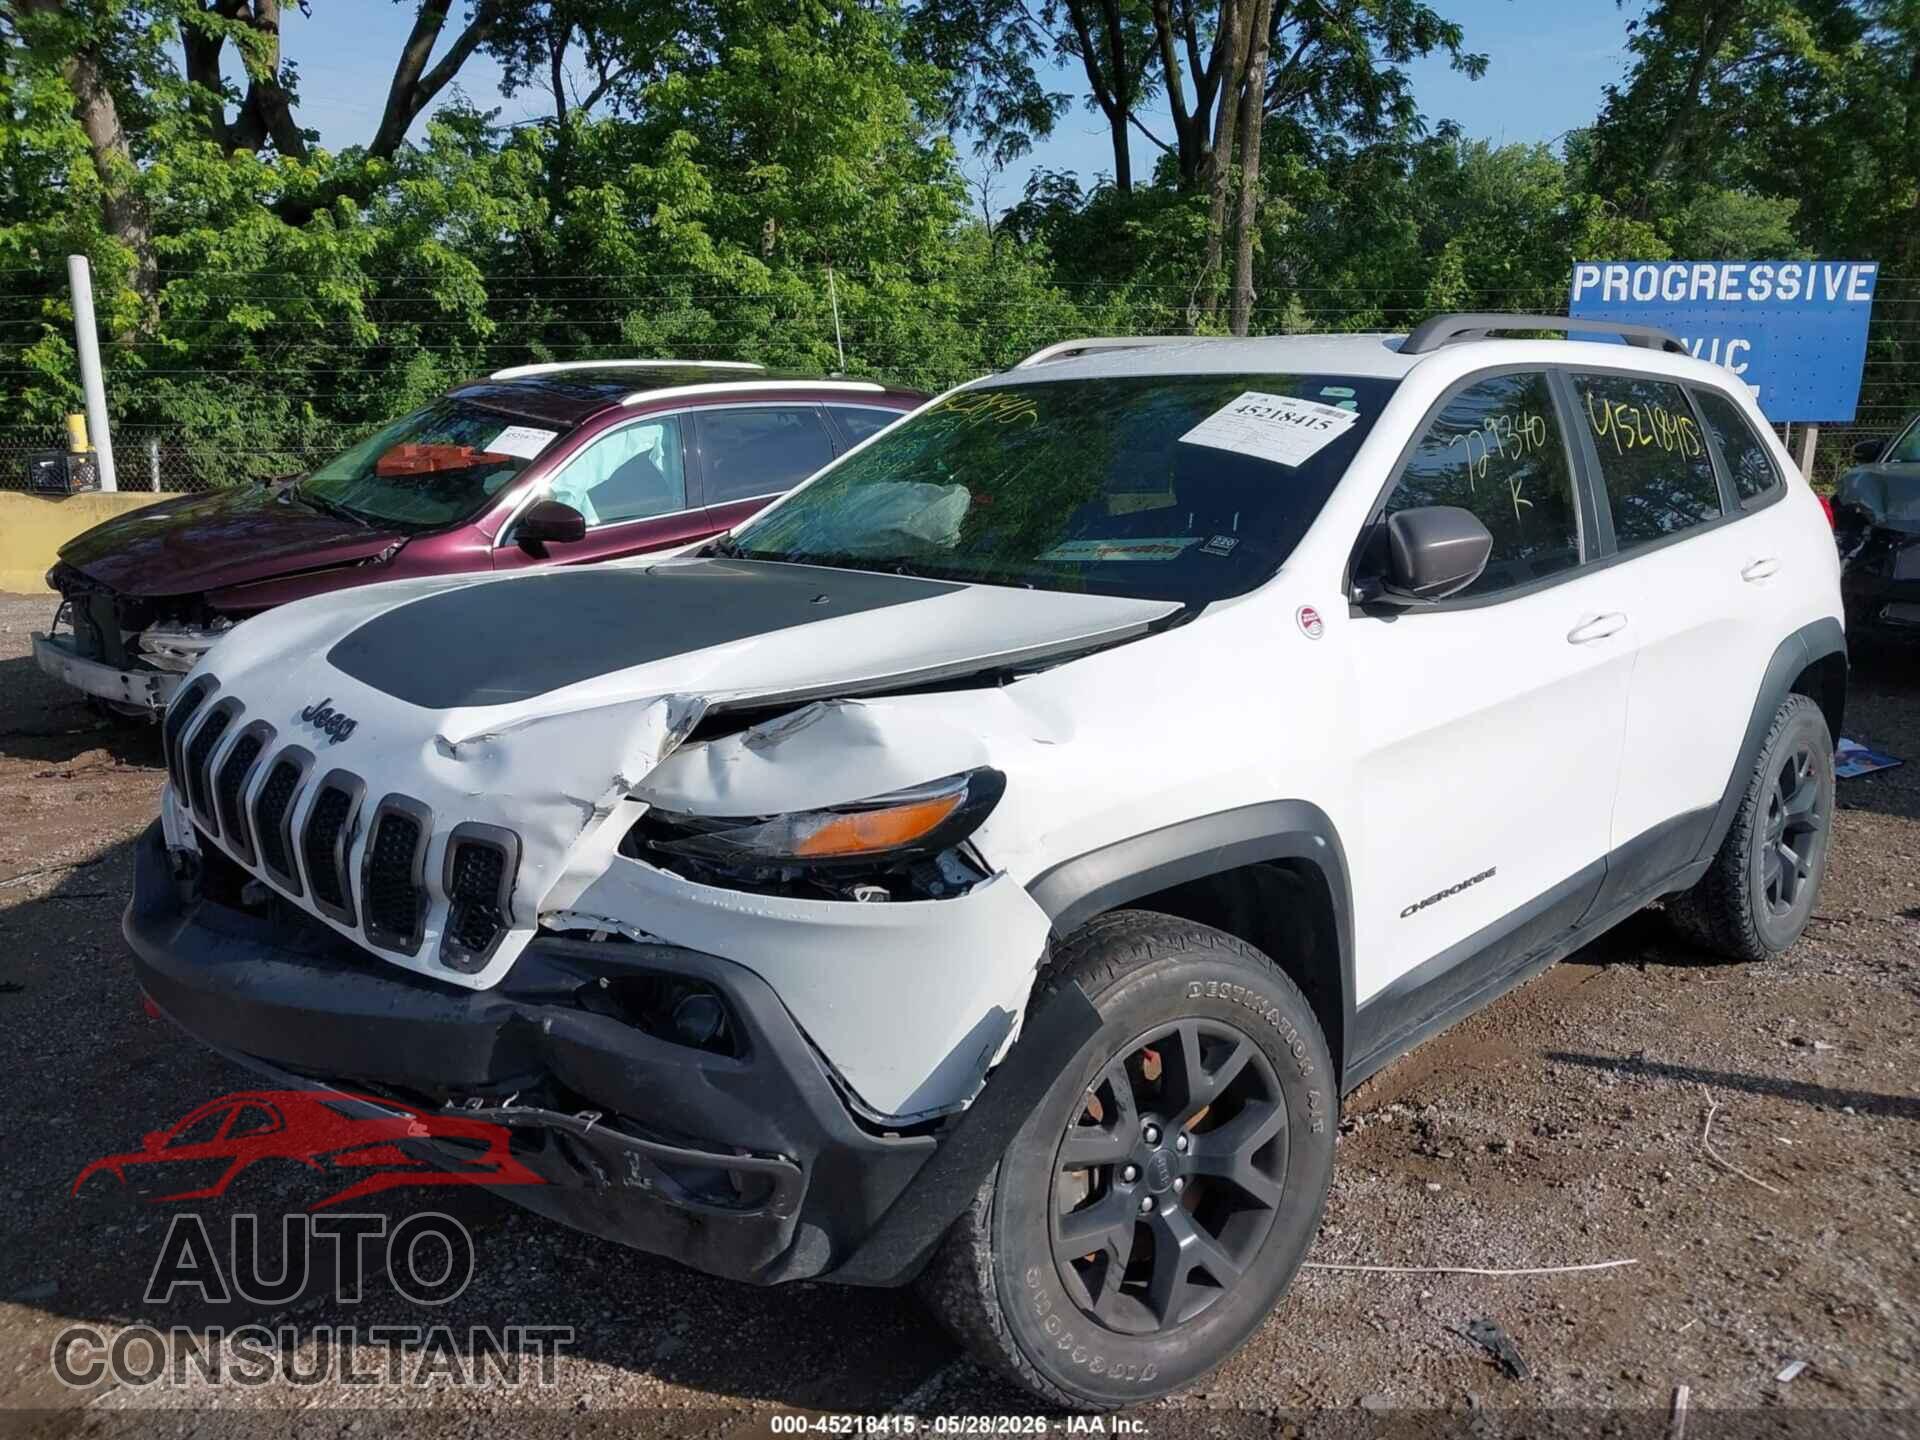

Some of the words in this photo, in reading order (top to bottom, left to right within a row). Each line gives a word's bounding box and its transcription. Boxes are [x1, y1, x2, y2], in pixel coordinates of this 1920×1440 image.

[1573, 264, 1876, 301] PROGRESSIVE
[1235, 403, 1334, 431] 45218415
[300, 697, 359, 745] Jeep
[1400, 865, 1497, 918] CHEROKEE
[1187, 980, 1314, 1078] DESTINATION
